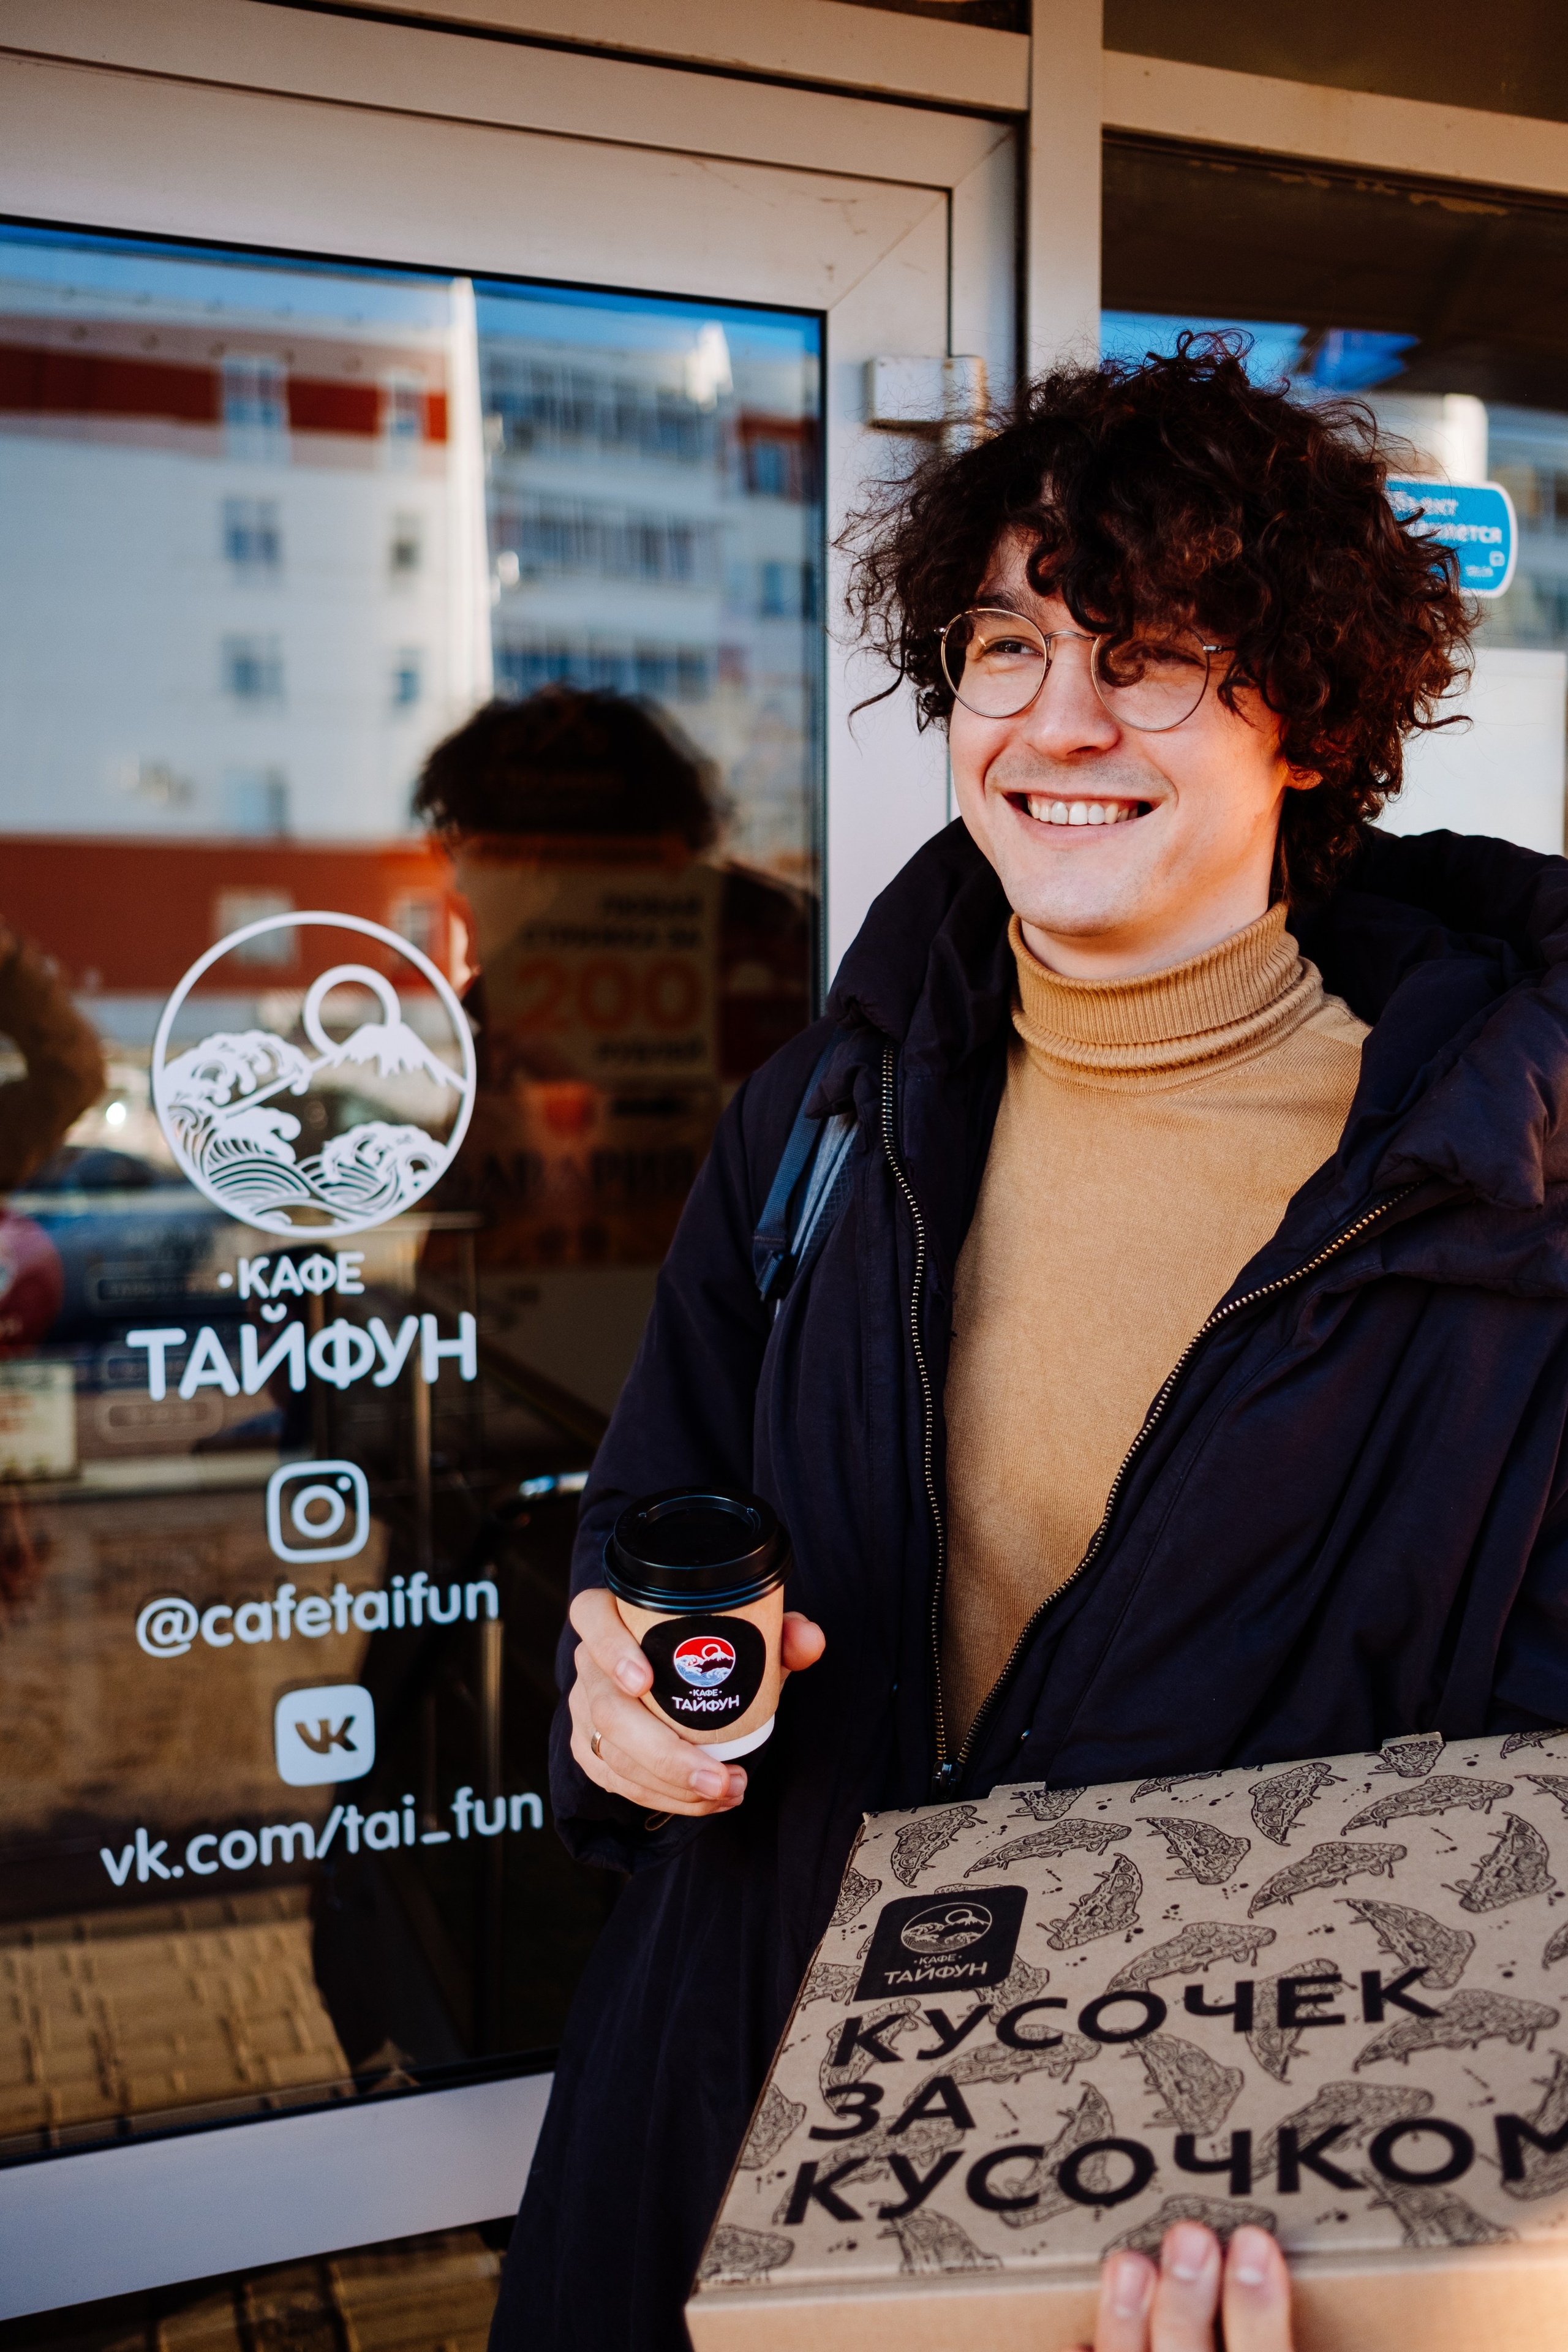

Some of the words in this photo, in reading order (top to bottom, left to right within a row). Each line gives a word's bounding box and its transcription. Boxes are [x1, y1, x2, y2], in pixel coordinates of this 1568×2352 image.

[514, 957, 701, 1034] 200
[239, 1251, 365, 1299] КАФЕ
[126, 1303, 477, 1402] ТАЙФУН
[135, 1572, 500, 1659] @cafetaifun
[671, 1695, 739, 1711] ТАЙФУН
[99, 1785, 543, 1887] vk.com/tai_fun
[884, 1961, 988, 1985] ТАЙФУН
[831, 1966, 1444, 2067] КУСОЧЕК
[807, 2075, 977, 2141] ЗА
